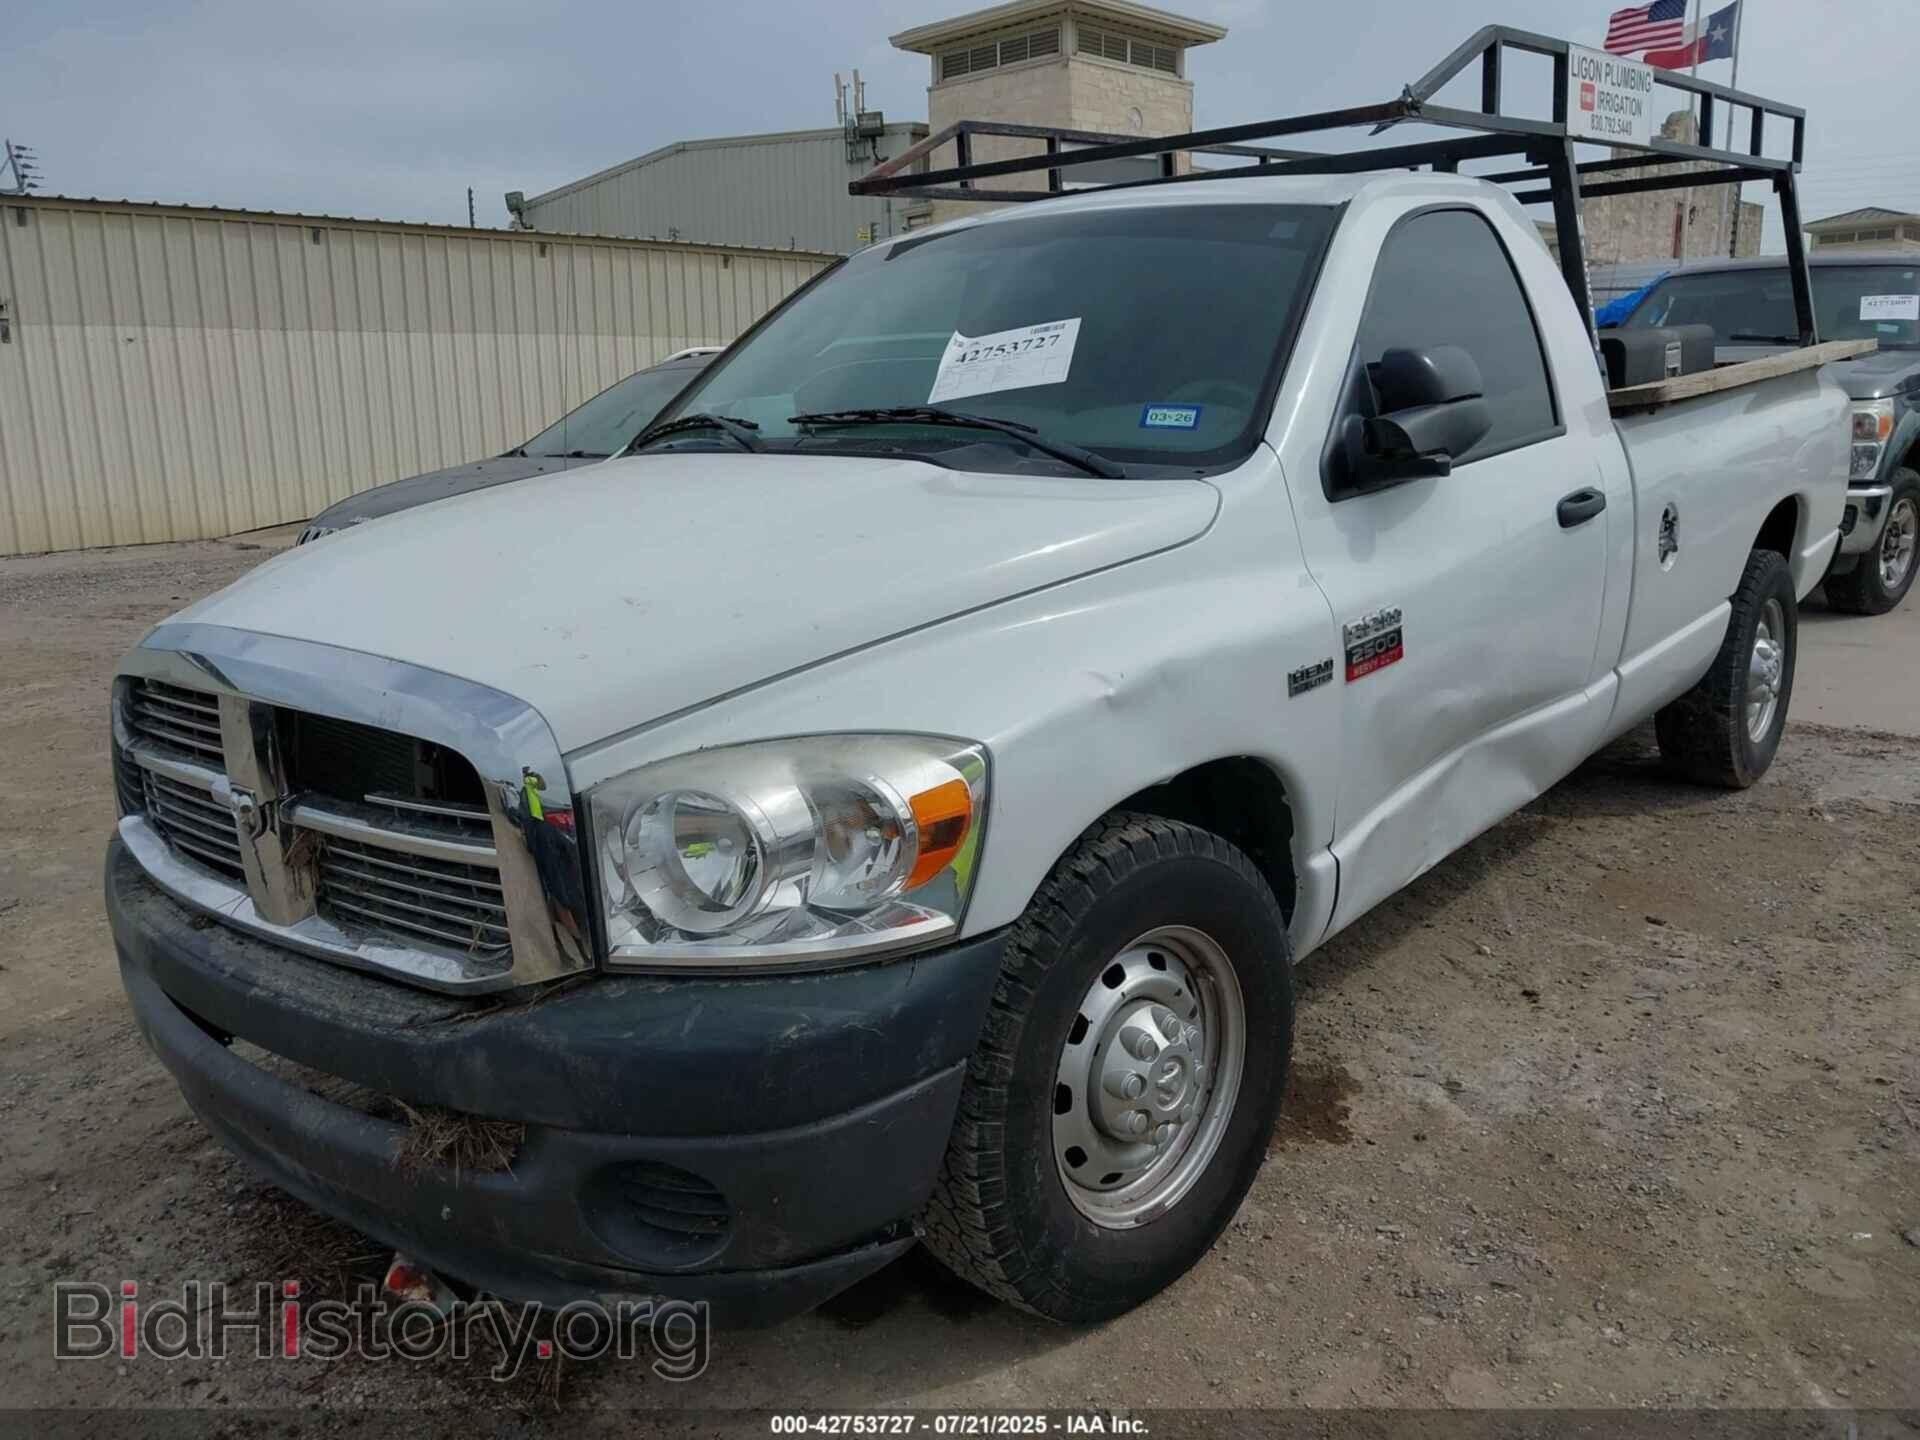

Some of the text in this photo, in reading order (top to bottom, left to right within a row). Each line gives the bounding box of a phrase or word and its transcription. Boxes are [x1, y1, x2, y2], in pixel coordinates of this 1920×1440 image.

[1571, 54, 1651, 93] LIGON PLUMBING
[1597, 90, 1642, 117] IRRIGATION
[955, 334, 1060, 363] 42753727
[1352, 633, 1398, 663] 2500
[1291, 657, 1334, 685] HEMI
